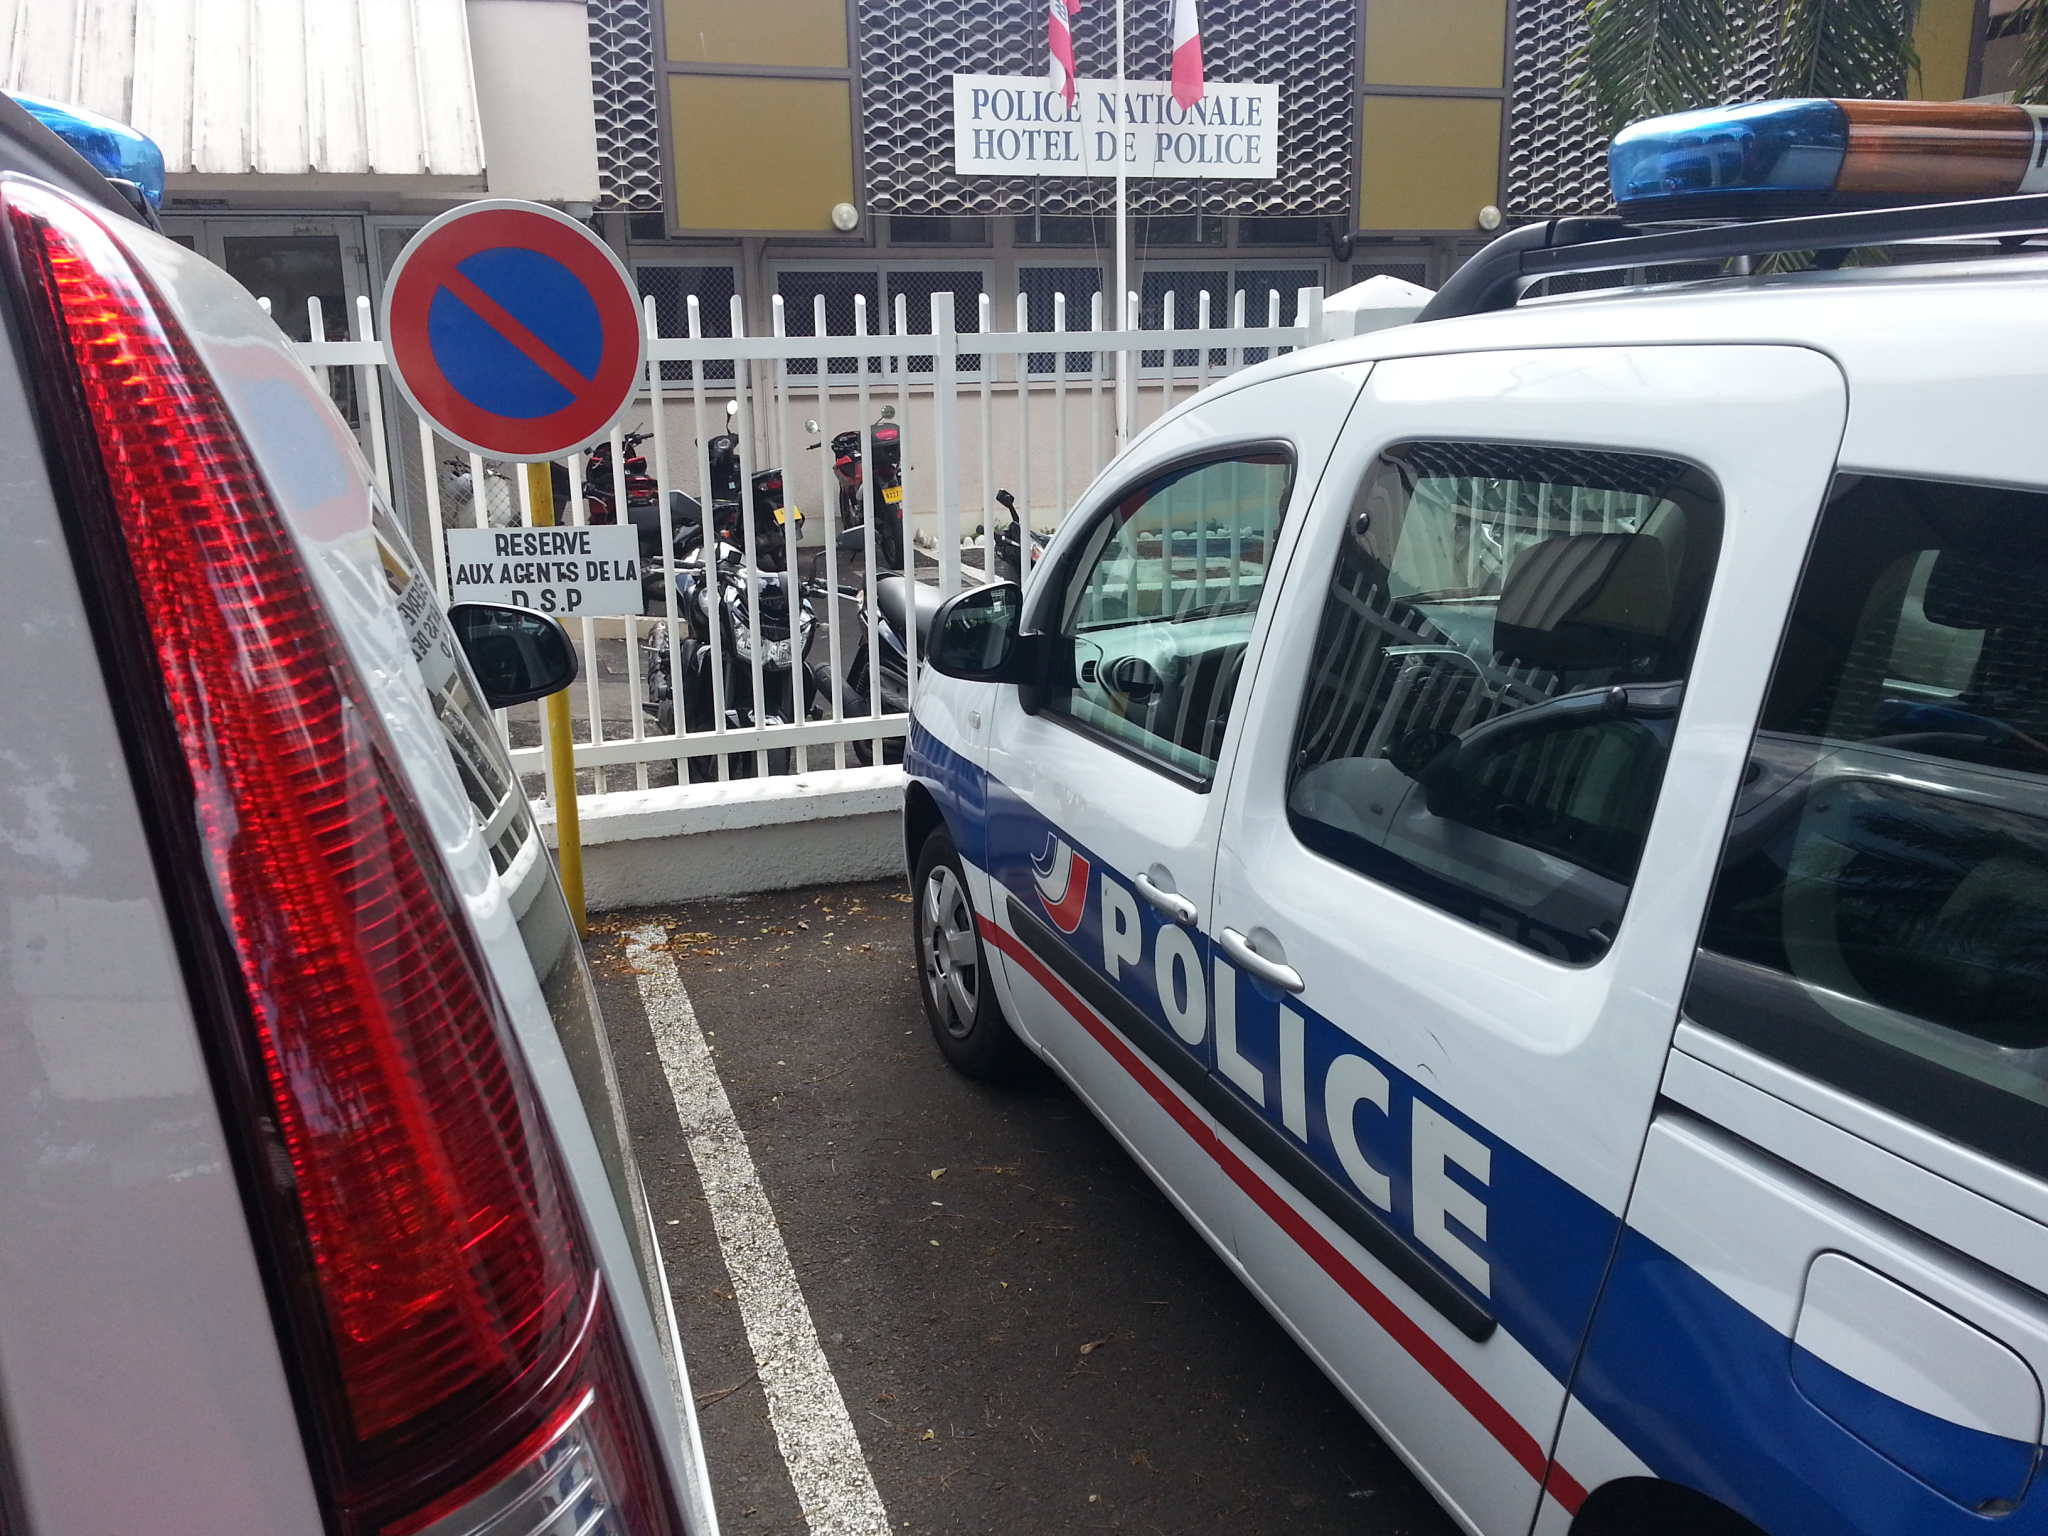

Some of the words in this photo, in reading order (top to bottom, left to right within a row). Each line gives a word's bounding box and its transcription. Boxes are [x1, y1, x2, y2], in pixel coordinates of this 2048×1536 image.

[971, 88, 1081, 123] POLICE
[1097, 92, 1262, 126] NATIONALE
[972, 128, 1080, 161] HOTEL
[1095, 131, 1137, 162] DE
[1155, 132, 1261, 164] POLICE
[494, 531, 592, 557] RESERVE
[456, 563, 495, 585] AUX
[499, 561, 580, 584] AGENTS
[586, 560, 610, 582] DE
[614, 559, 638, 580] LA
[1101, 871, 1491, 1300] POLICE
